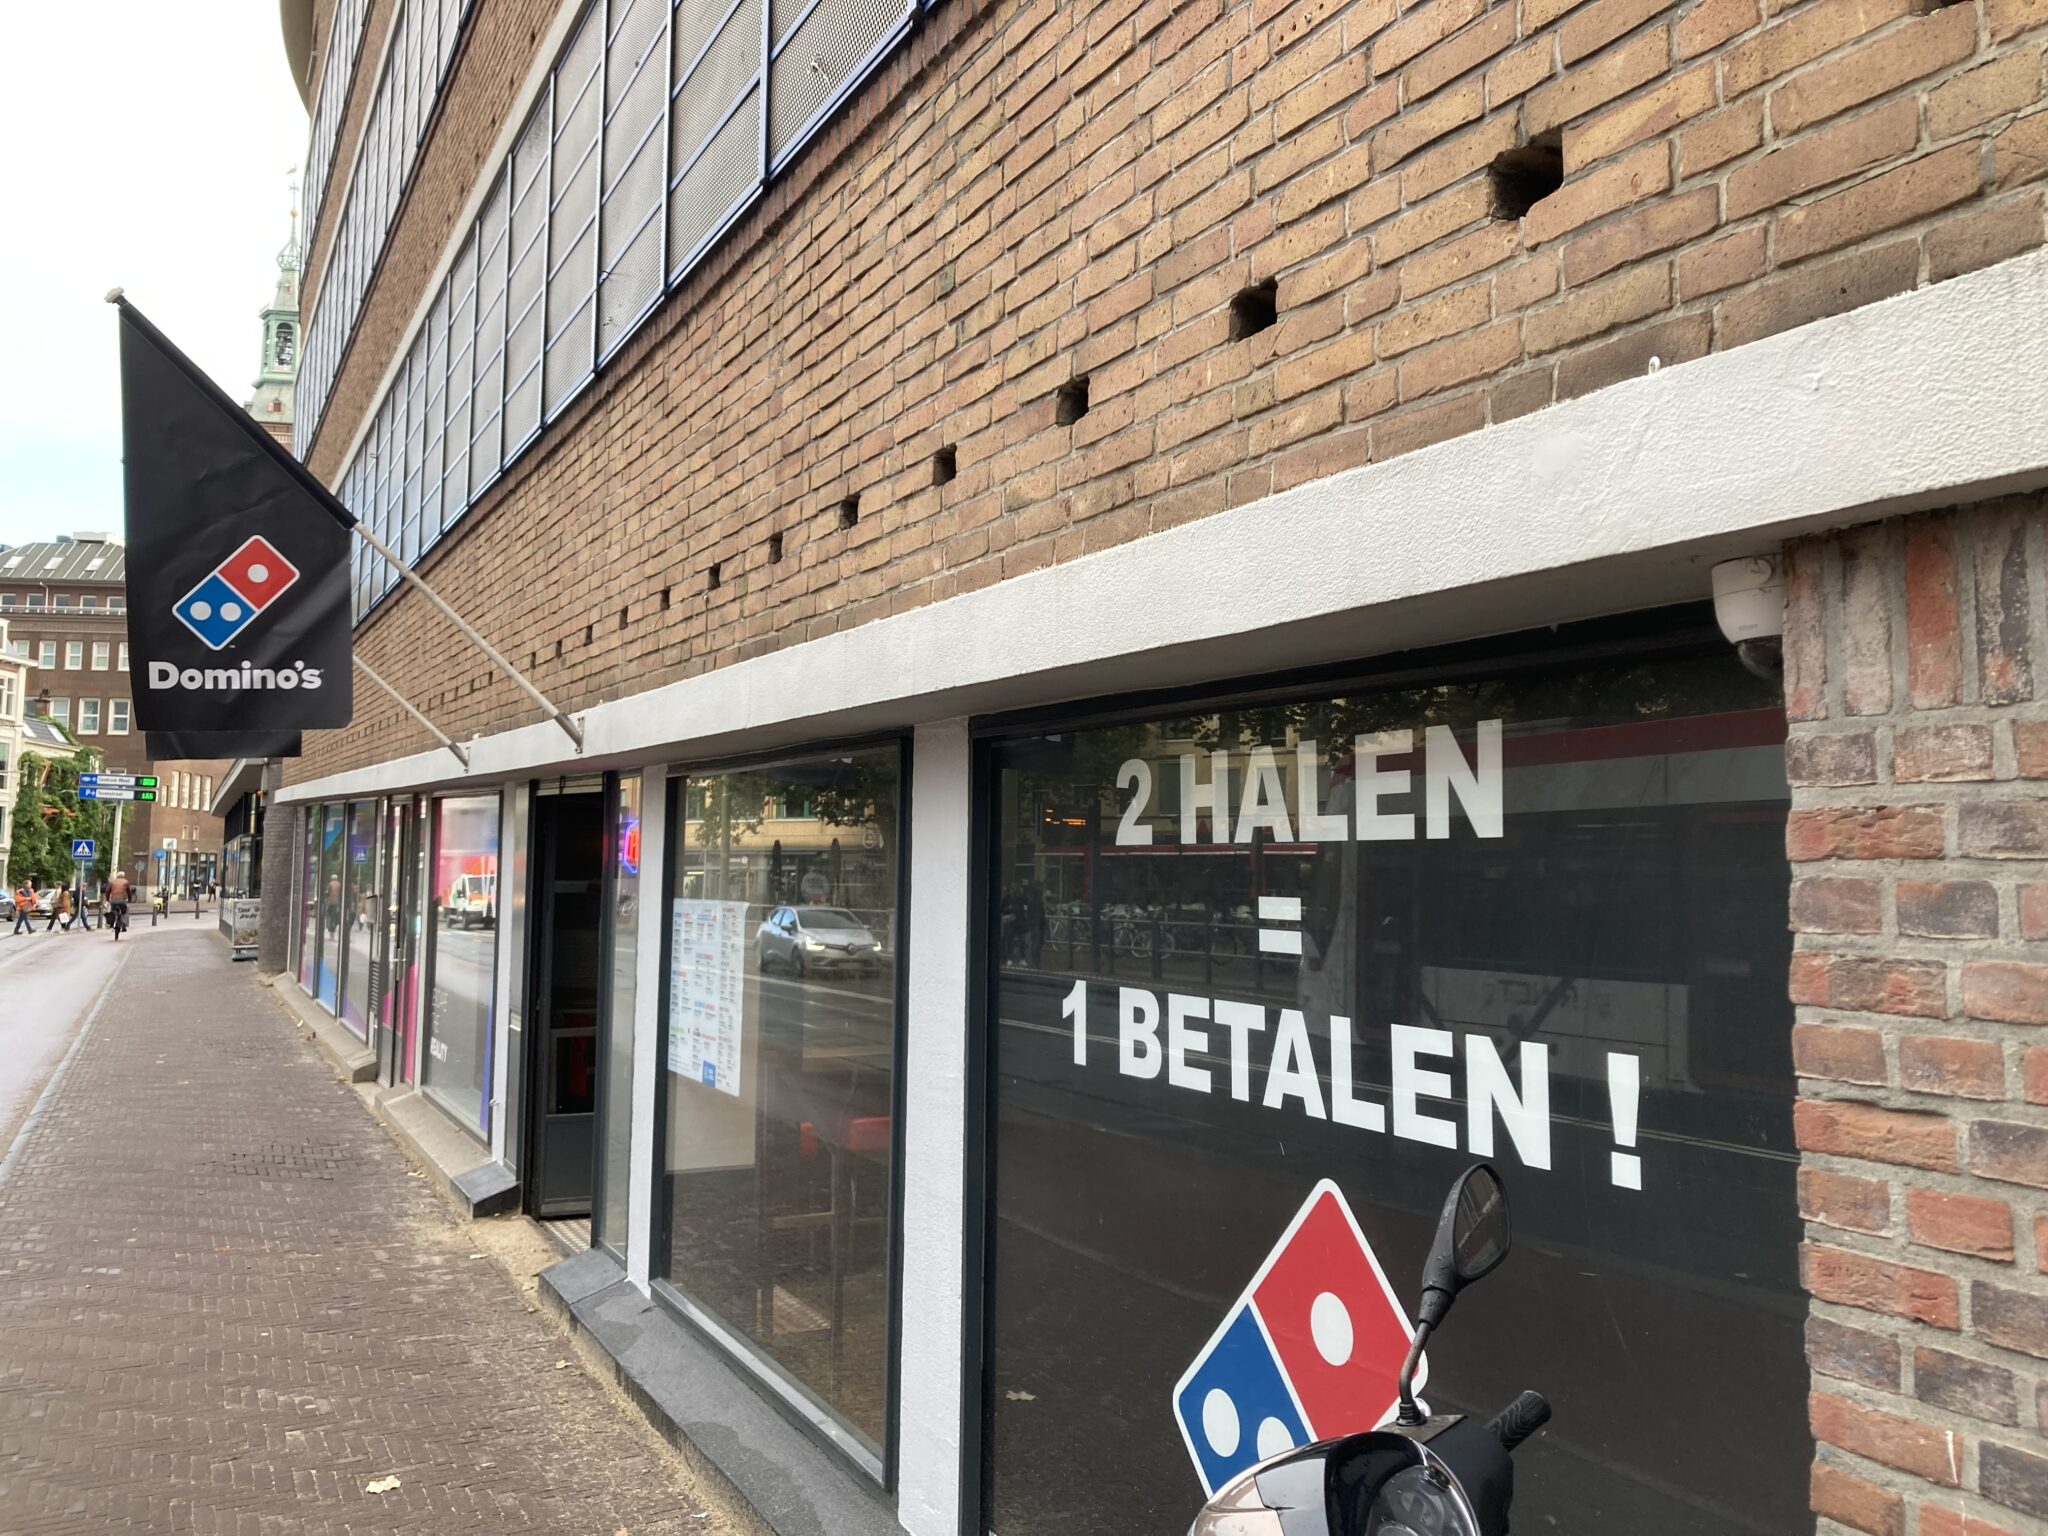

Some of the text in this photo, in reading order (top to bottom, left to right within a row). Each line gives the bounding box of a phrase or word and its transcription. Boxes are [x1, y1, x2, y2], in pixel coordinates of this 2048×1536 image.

[148, 660, 322, 690] Domino's
[1115, 718, 1504, 846] 2 HALEN
[1061, 979, 1087, 1066] 1
[1118, 986, 1552, 1171] BETALEN
